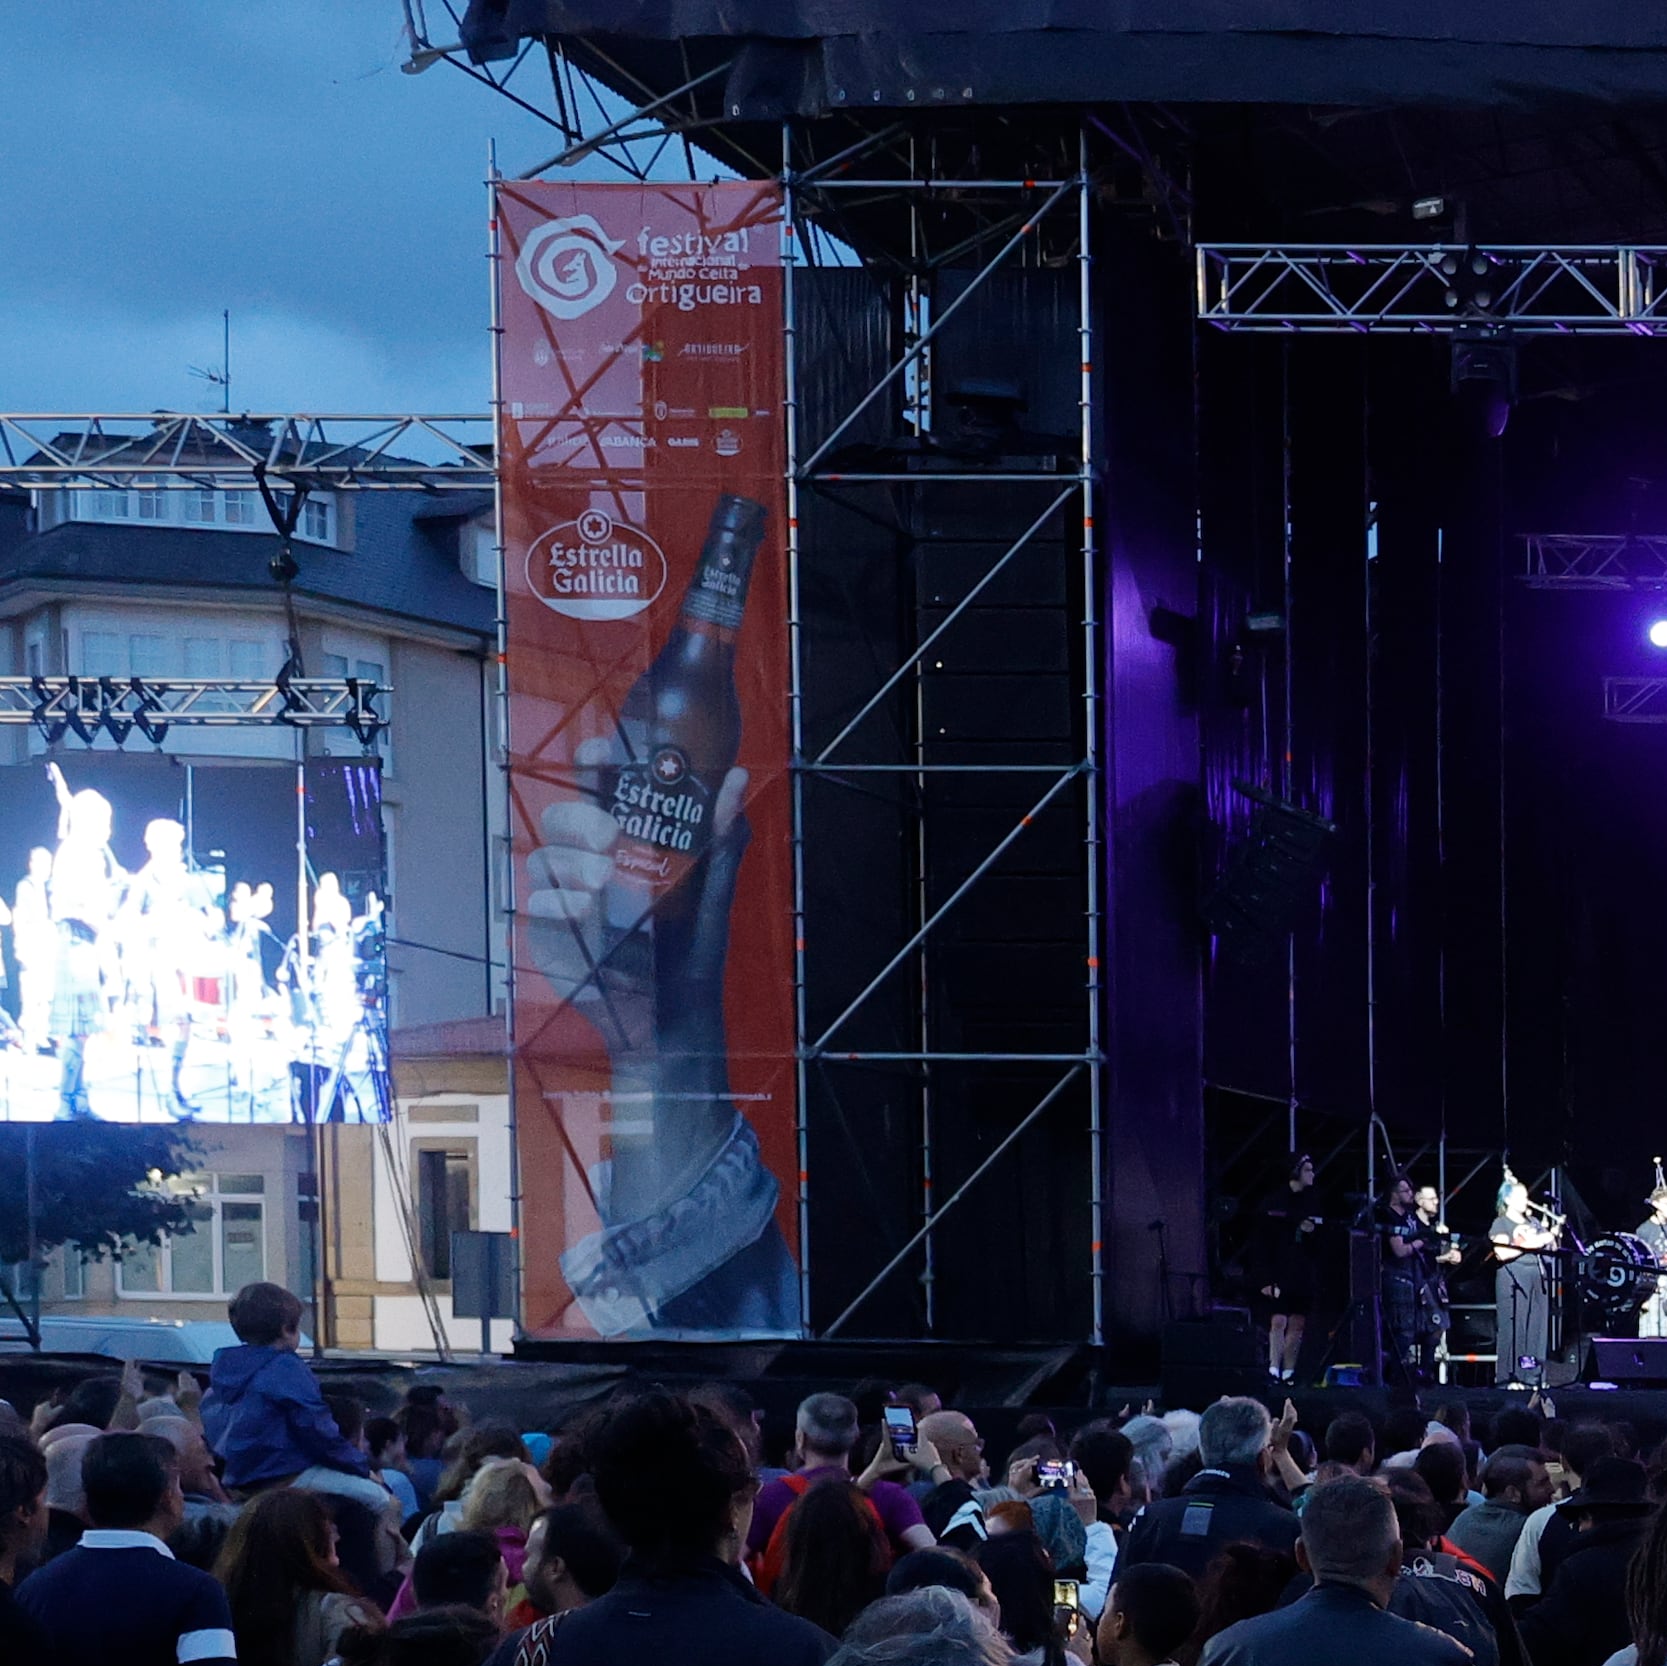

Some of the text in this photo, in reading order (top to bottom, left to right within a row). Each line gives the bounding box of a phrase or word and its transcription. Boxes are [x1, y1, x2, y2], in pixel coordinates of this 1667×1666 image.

[637, 226, 748, 256] festival
[626, 280, 762, 311] Ortigueira
[549, 542, 642, 567] Estrella
[553, 568, 639, 593] Galicia
[614, 770, 704, 824] Estrella
